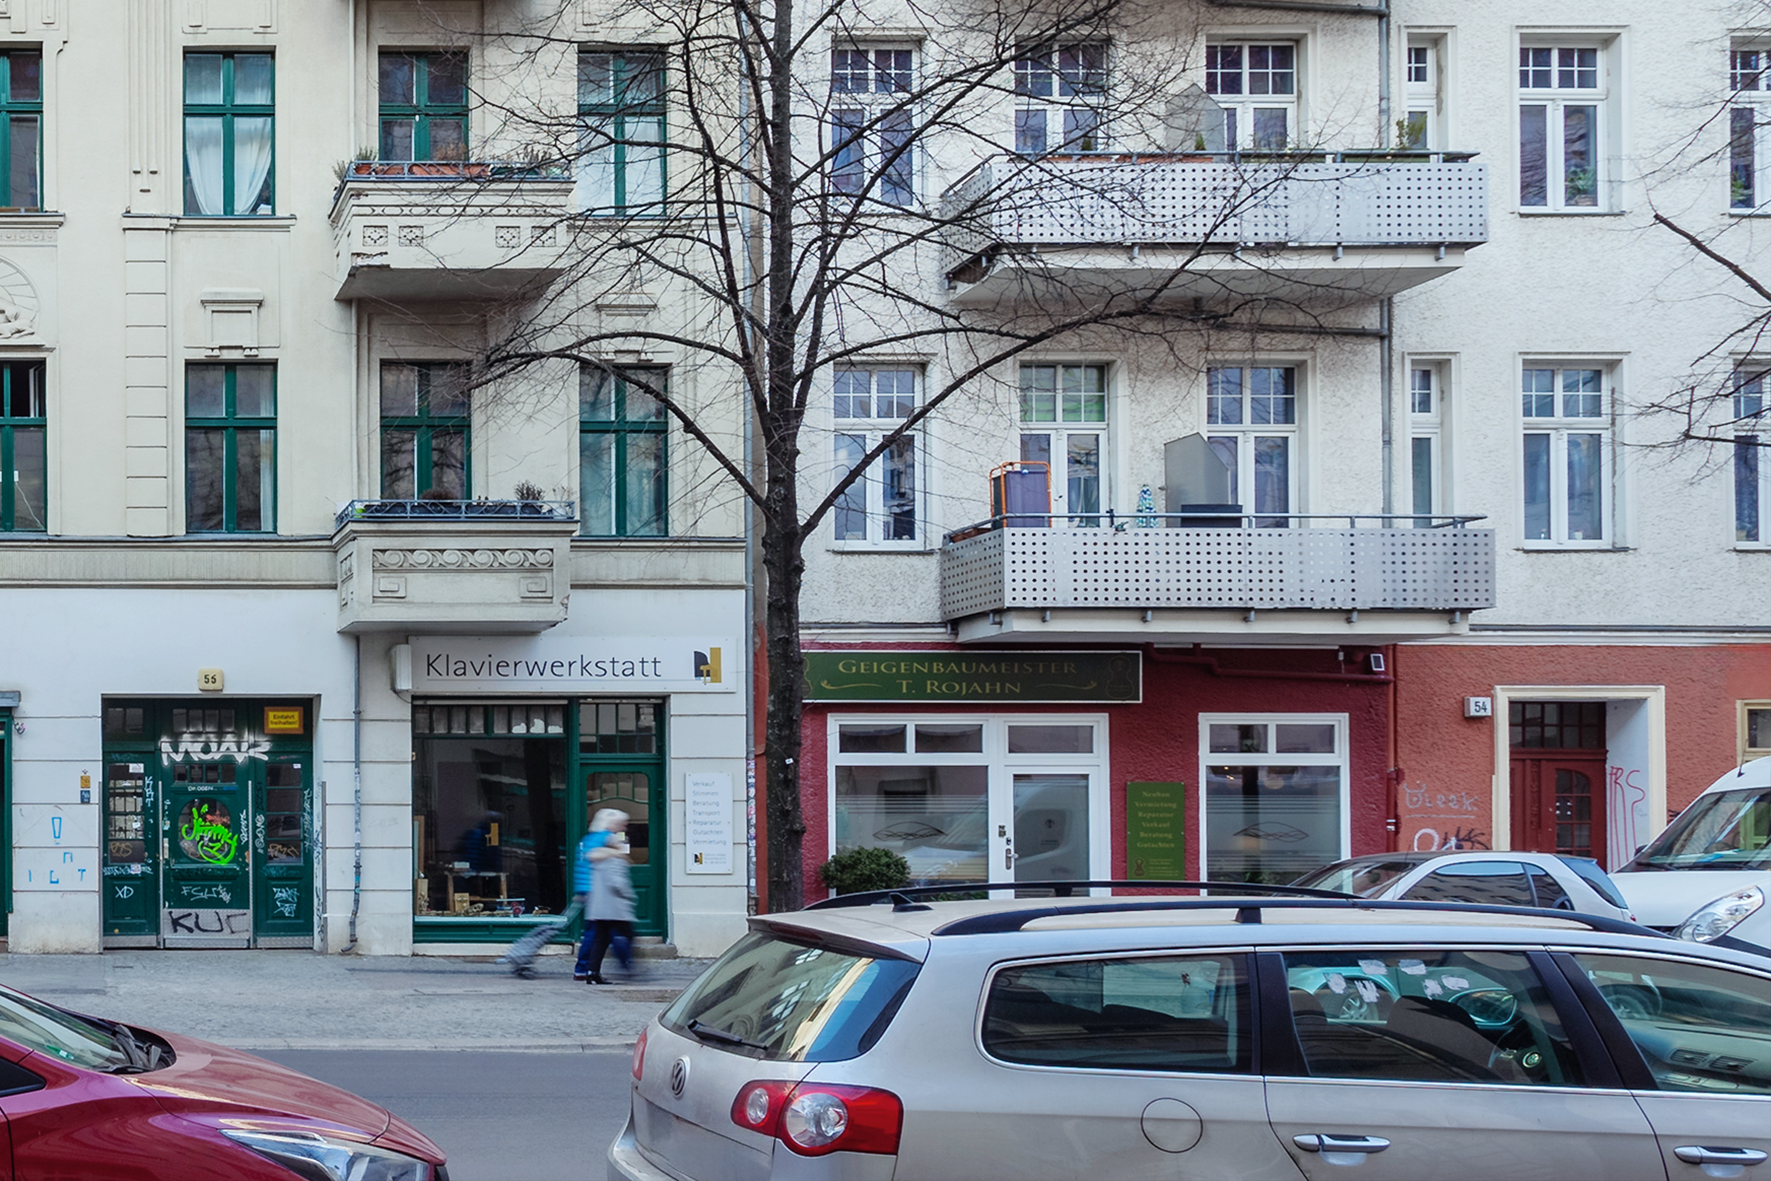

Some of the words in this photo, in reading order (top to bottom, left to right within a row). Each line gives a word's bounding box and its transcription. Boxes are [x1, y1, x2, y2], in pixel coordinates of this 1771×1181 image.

[426, 653, 663, 678] Klavierwerkstatt
[895, 679, 916, 693] T.
[1474, 700, 1488, 713] 54
[1139, 831, 1173, 839] Beratung
